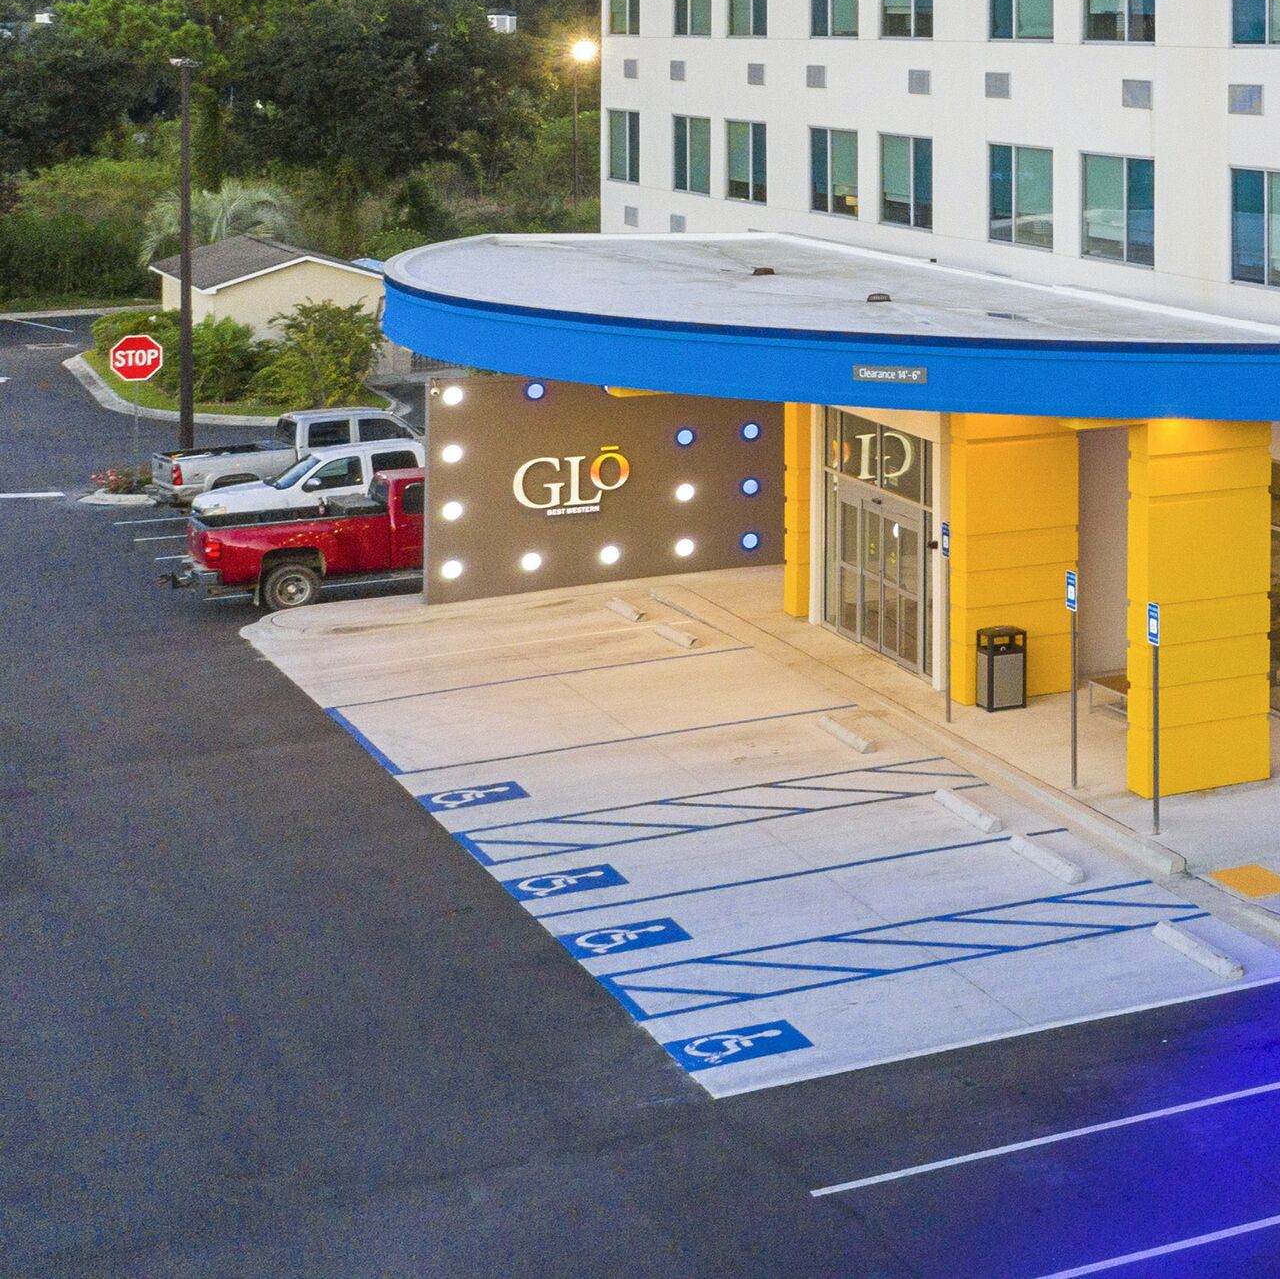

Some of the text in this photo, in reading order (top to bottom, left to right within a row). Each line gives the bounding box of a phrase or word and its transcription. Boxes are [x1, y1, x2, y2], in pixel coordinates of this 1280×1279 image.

[114, 349, 159, 368] STOP
[859, 368, 896, 379] Clearance
[546, 508, 565, 516] BEST
